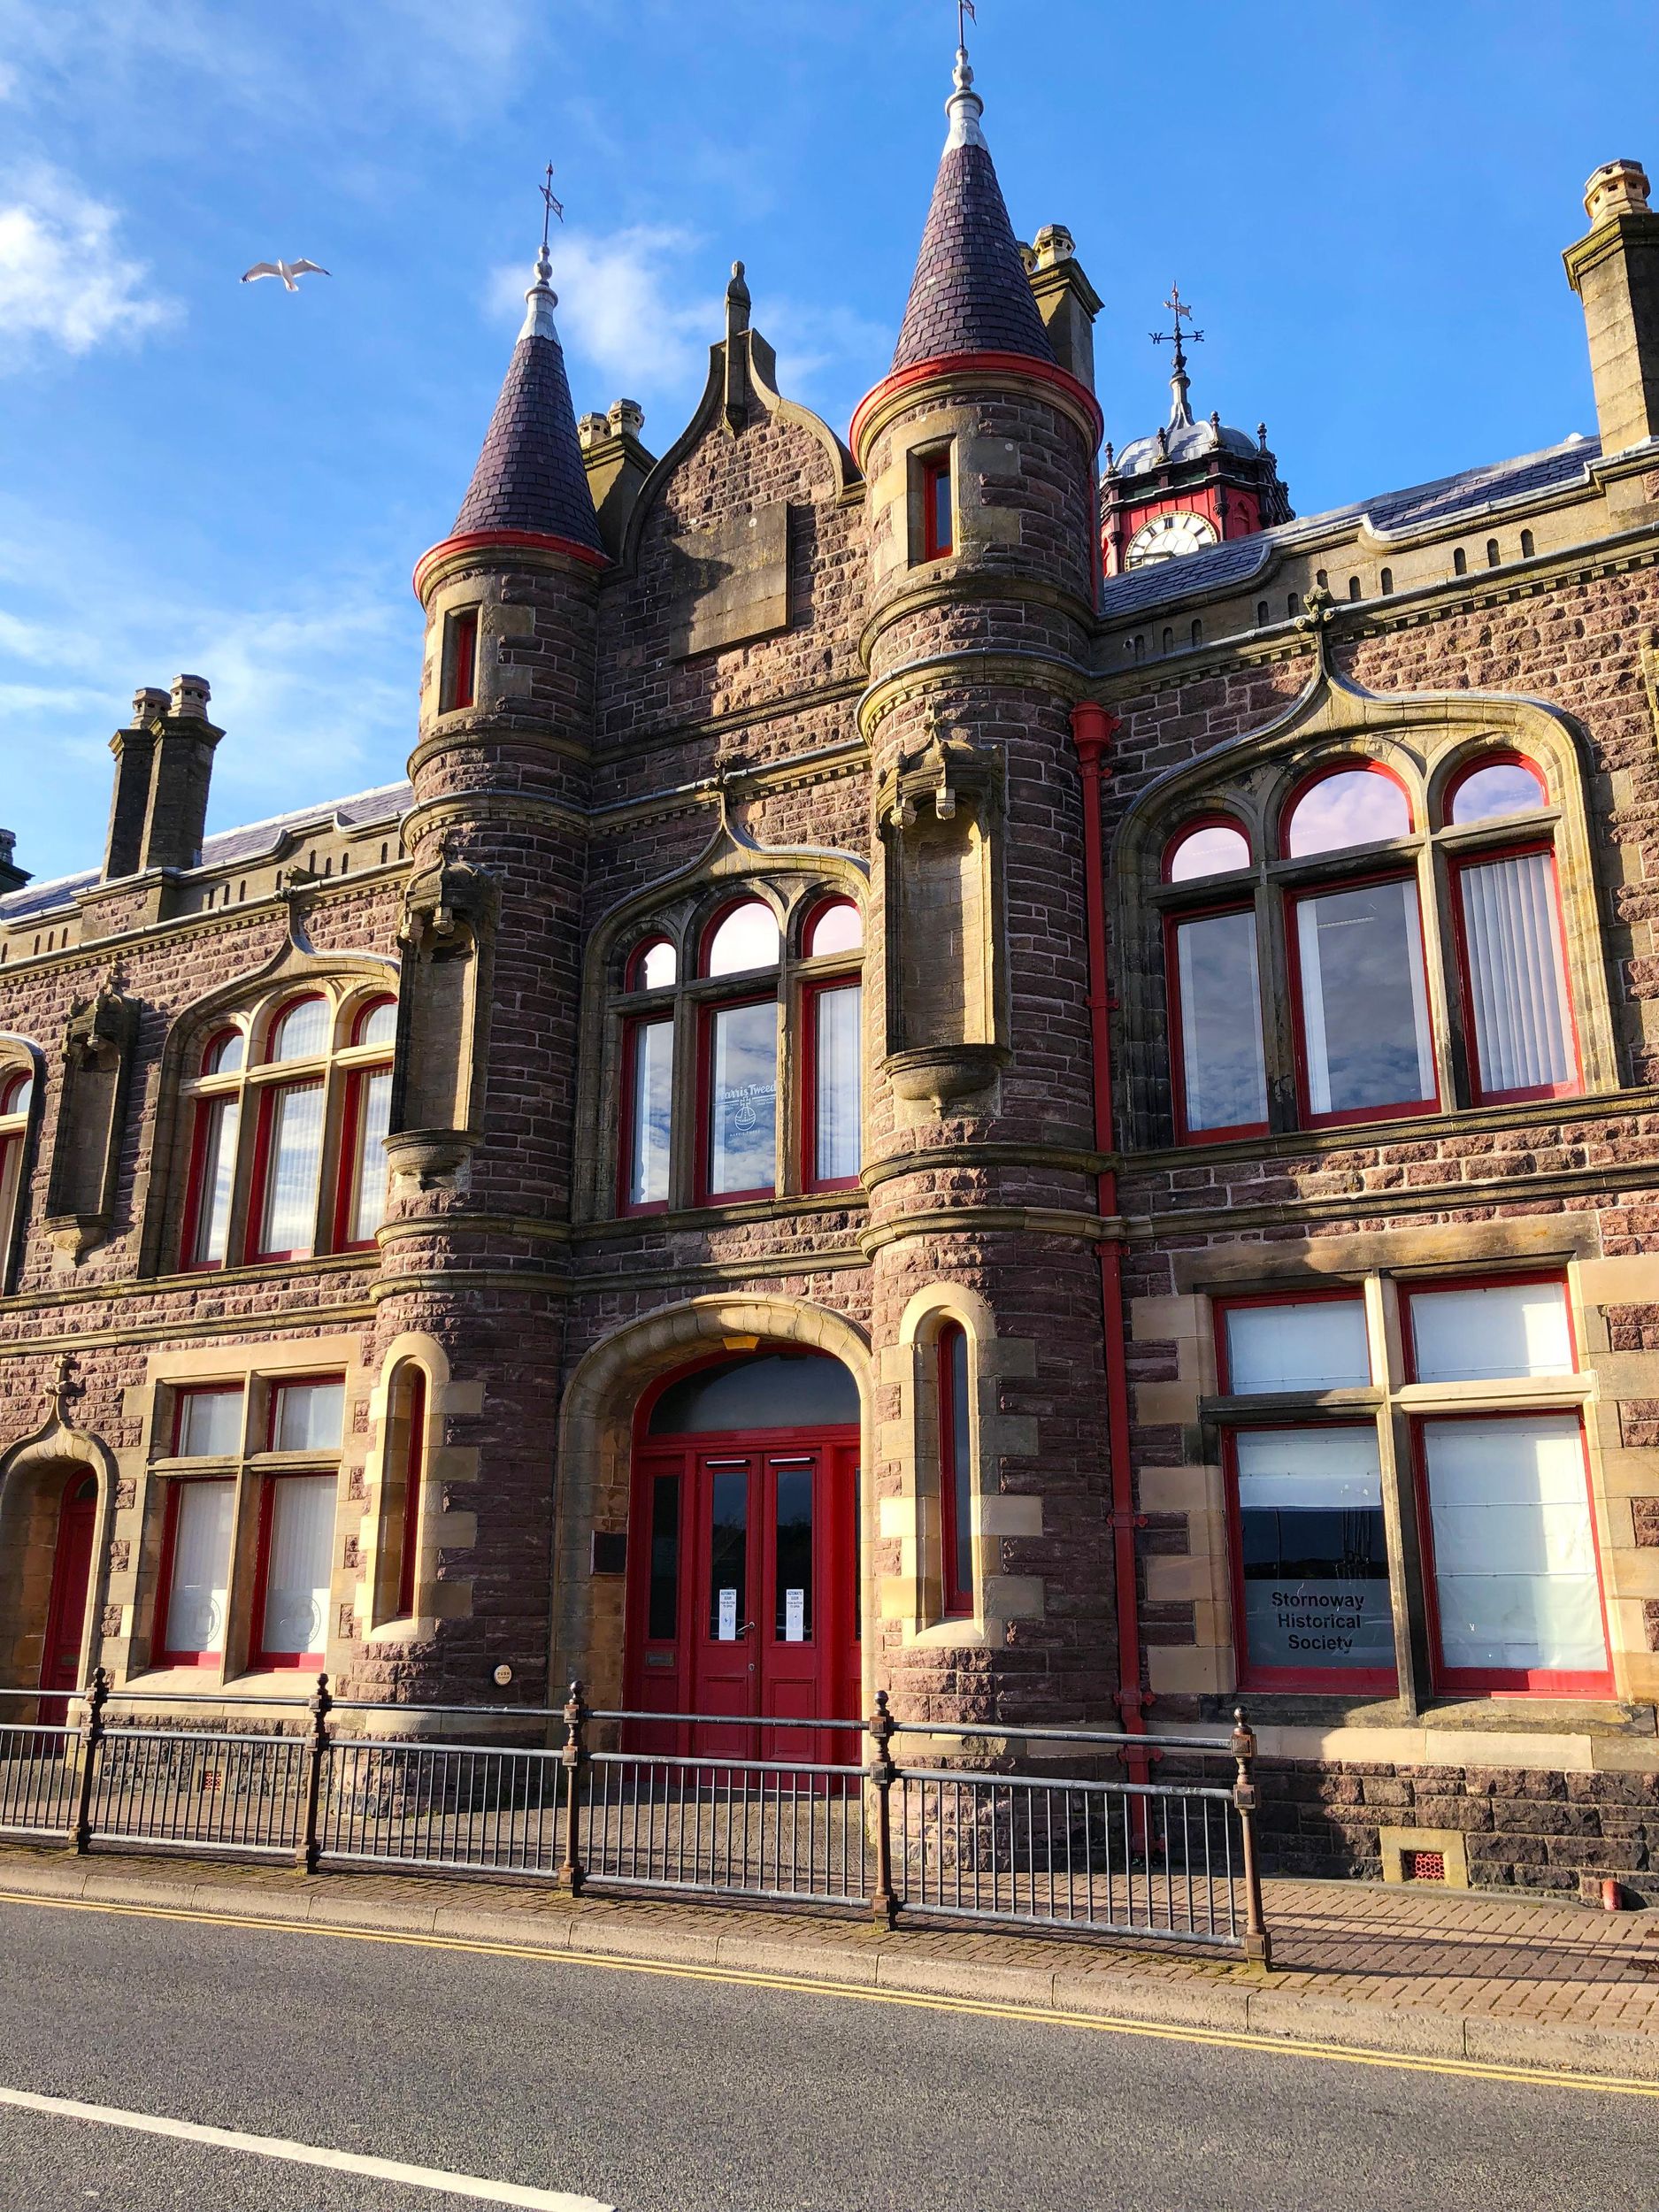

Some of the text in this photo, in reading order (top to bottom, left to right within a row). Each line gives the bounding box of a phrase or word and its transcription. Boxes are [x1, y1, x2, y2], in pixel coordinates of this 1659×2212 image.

[748, 1081, 777, 1095] Tweed
[1271, 1592, 1364, 1610] Stornoway
[1278, 1614, 1361, 1629] Historical
[1288, 1634, 1353, 1654] Society
